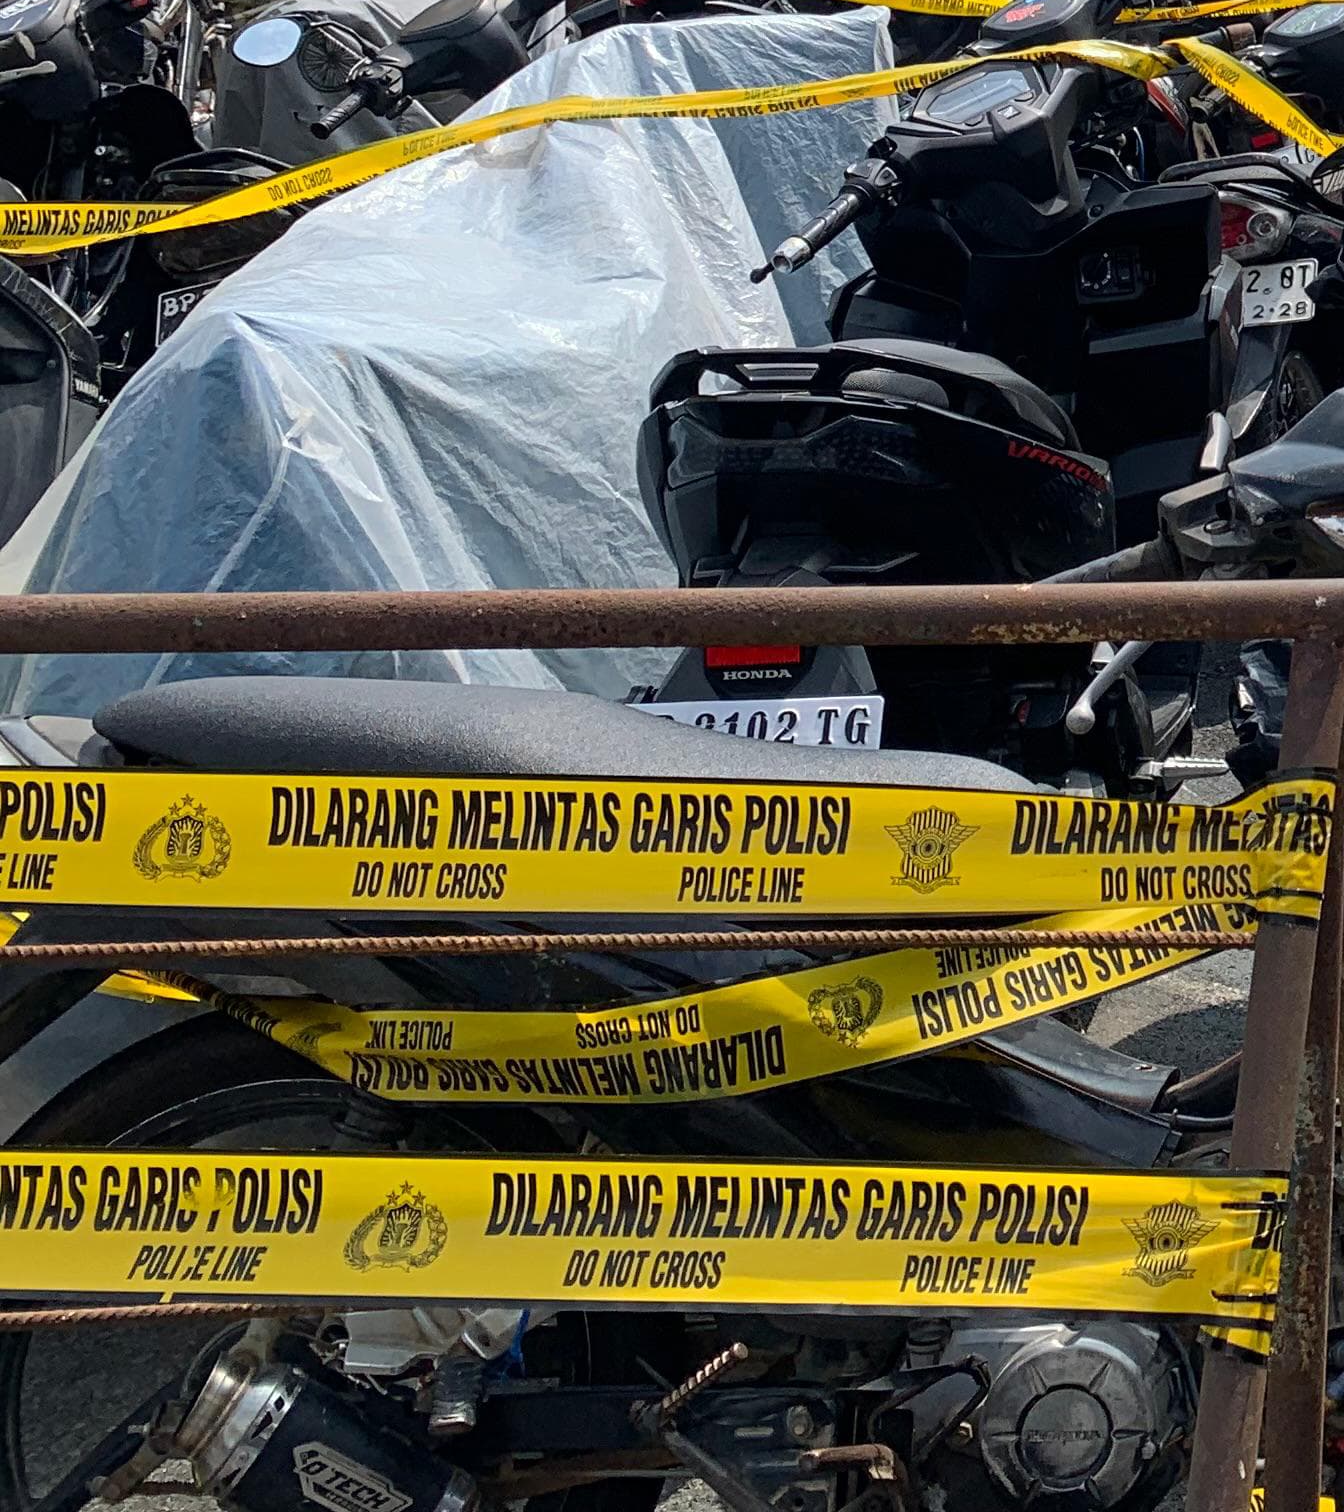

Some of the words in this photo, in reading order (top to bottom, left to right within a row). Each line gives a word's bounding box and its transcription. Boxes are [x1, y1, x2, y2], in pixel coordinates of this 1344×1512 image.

[3, 208, 82, 236] MELINTAS
[82, 209, 131, 235] GARIS
[161, 293, 196, 317] BP
[1008, 440, 1091, 483] VARIO
[723, 669, 793, 683] HONDA
[817, 706, 872, 745] TG
[0, 781, 107, 843] POLISI
[268, 786, 437, 850] DILARANG
[447, 789, 623, 854] MELINTAS
[630, 792, 731, 855] GARIS
[742, 796, 851, 855] POLISI
[1011, 800, 1178, 855] DILARANG
[8, 854, 58, 890] LINE
[351, 861, 384, 898] DO
[387, 862, 432, 899] NOT
[436, 862, 508, 900] CROSS
[678, 866, 752, 903] POLICE
[756, 866, 805, 904] LINE
[1101, 866, 1129, 900] DO
[1135, 865, 1176, 900] NOT
[1182, 863, 1251, 899] CROSS
[935, 949, 973, 979] LINE
[1005, 951, 1088, 1011] GARIS
[638, 1007, 671, 1041] NOT
[676, 1003, 700, 1034] DO
[912, 976, 1003, 1039] POLISI
[400, 1019, 454, 1051] POLICE
[576, 1016, 633, 1050] CROSS
[507, 1051, 636, 1097] MELINTAS
[643, 1024, 787, 1095] DILARANG
[94, 1165, 201, 1233] GARIS
[206, 1168, 325, 1235] POLISI
[485, 1171, 662, 1237] DILARANG
[668, 1175, 851, 1241] MELINTAS
[855, 1178, 967, 1243] GARIS
[976, 1182, 1089, 1246] POLISI
[210, 1246, 268, 1282] LINE
[563, 1249, 596, 1286] DO
[598, 1250, 645, 1287] NOT
[649, 1250, 726, 1288] CROSS
[900, 1254, 981, 1294] POLICE
[983, 1256, 1036, 1296] LINE
